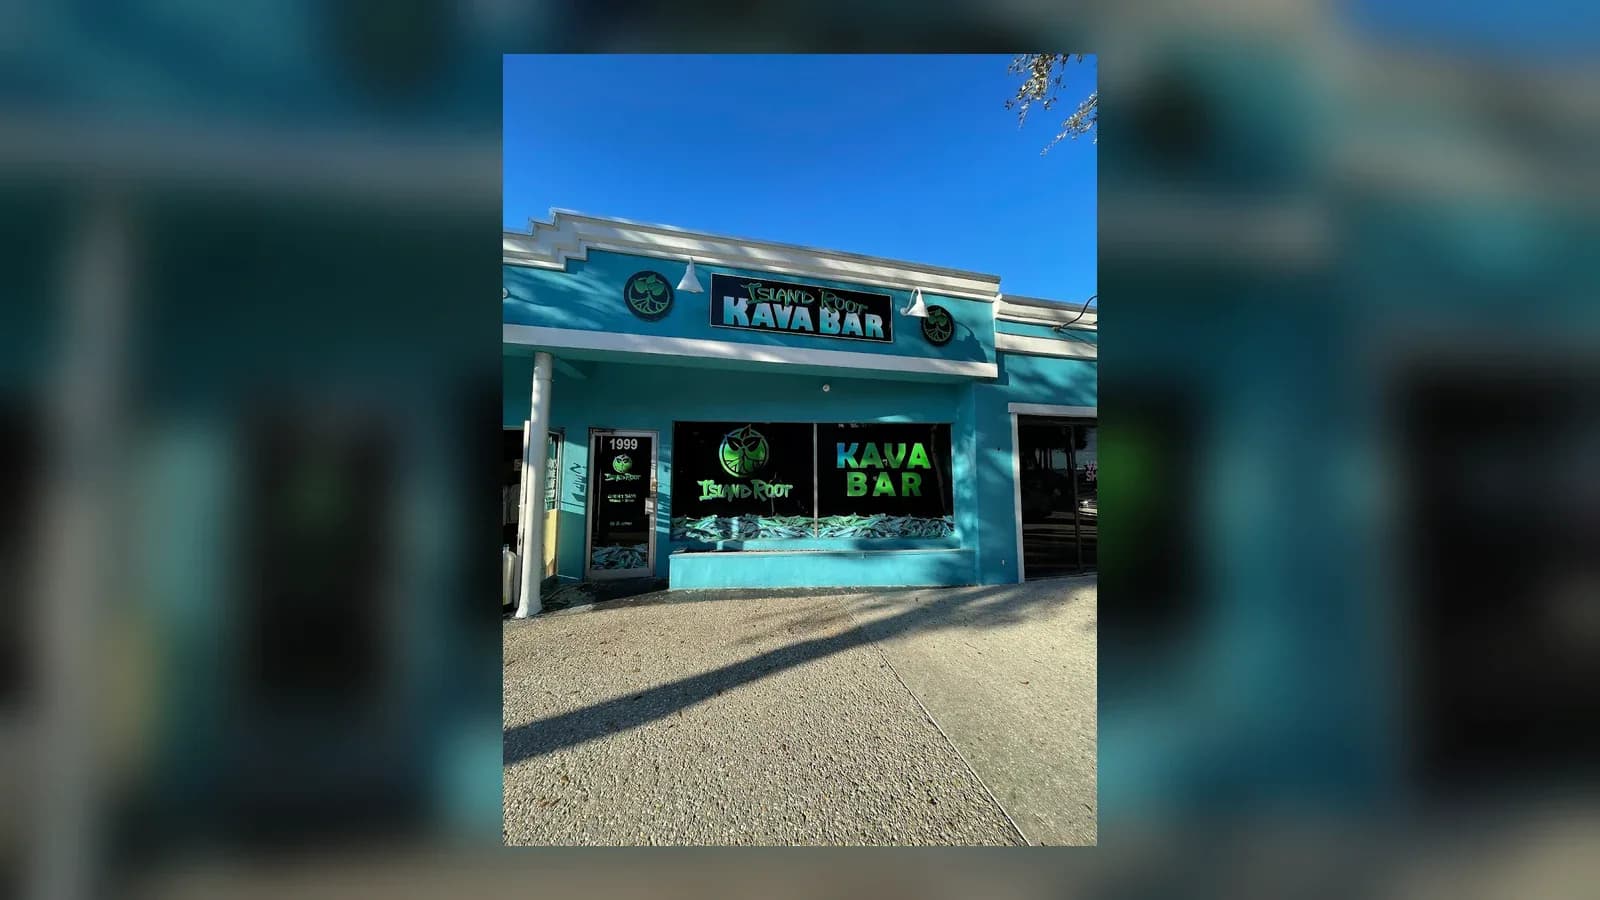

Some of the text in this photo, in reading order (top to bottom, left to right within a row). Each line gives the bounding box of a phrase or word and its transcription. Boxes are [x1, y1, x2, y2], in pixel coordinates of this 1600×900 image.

[723, 296, 884, 338] KAVA BAR
[609, 438, 637, 450] 1999
[836, 442, 931, 497] KAVA BAR
[697, 479, 793, 503] ISLAND ROOT
